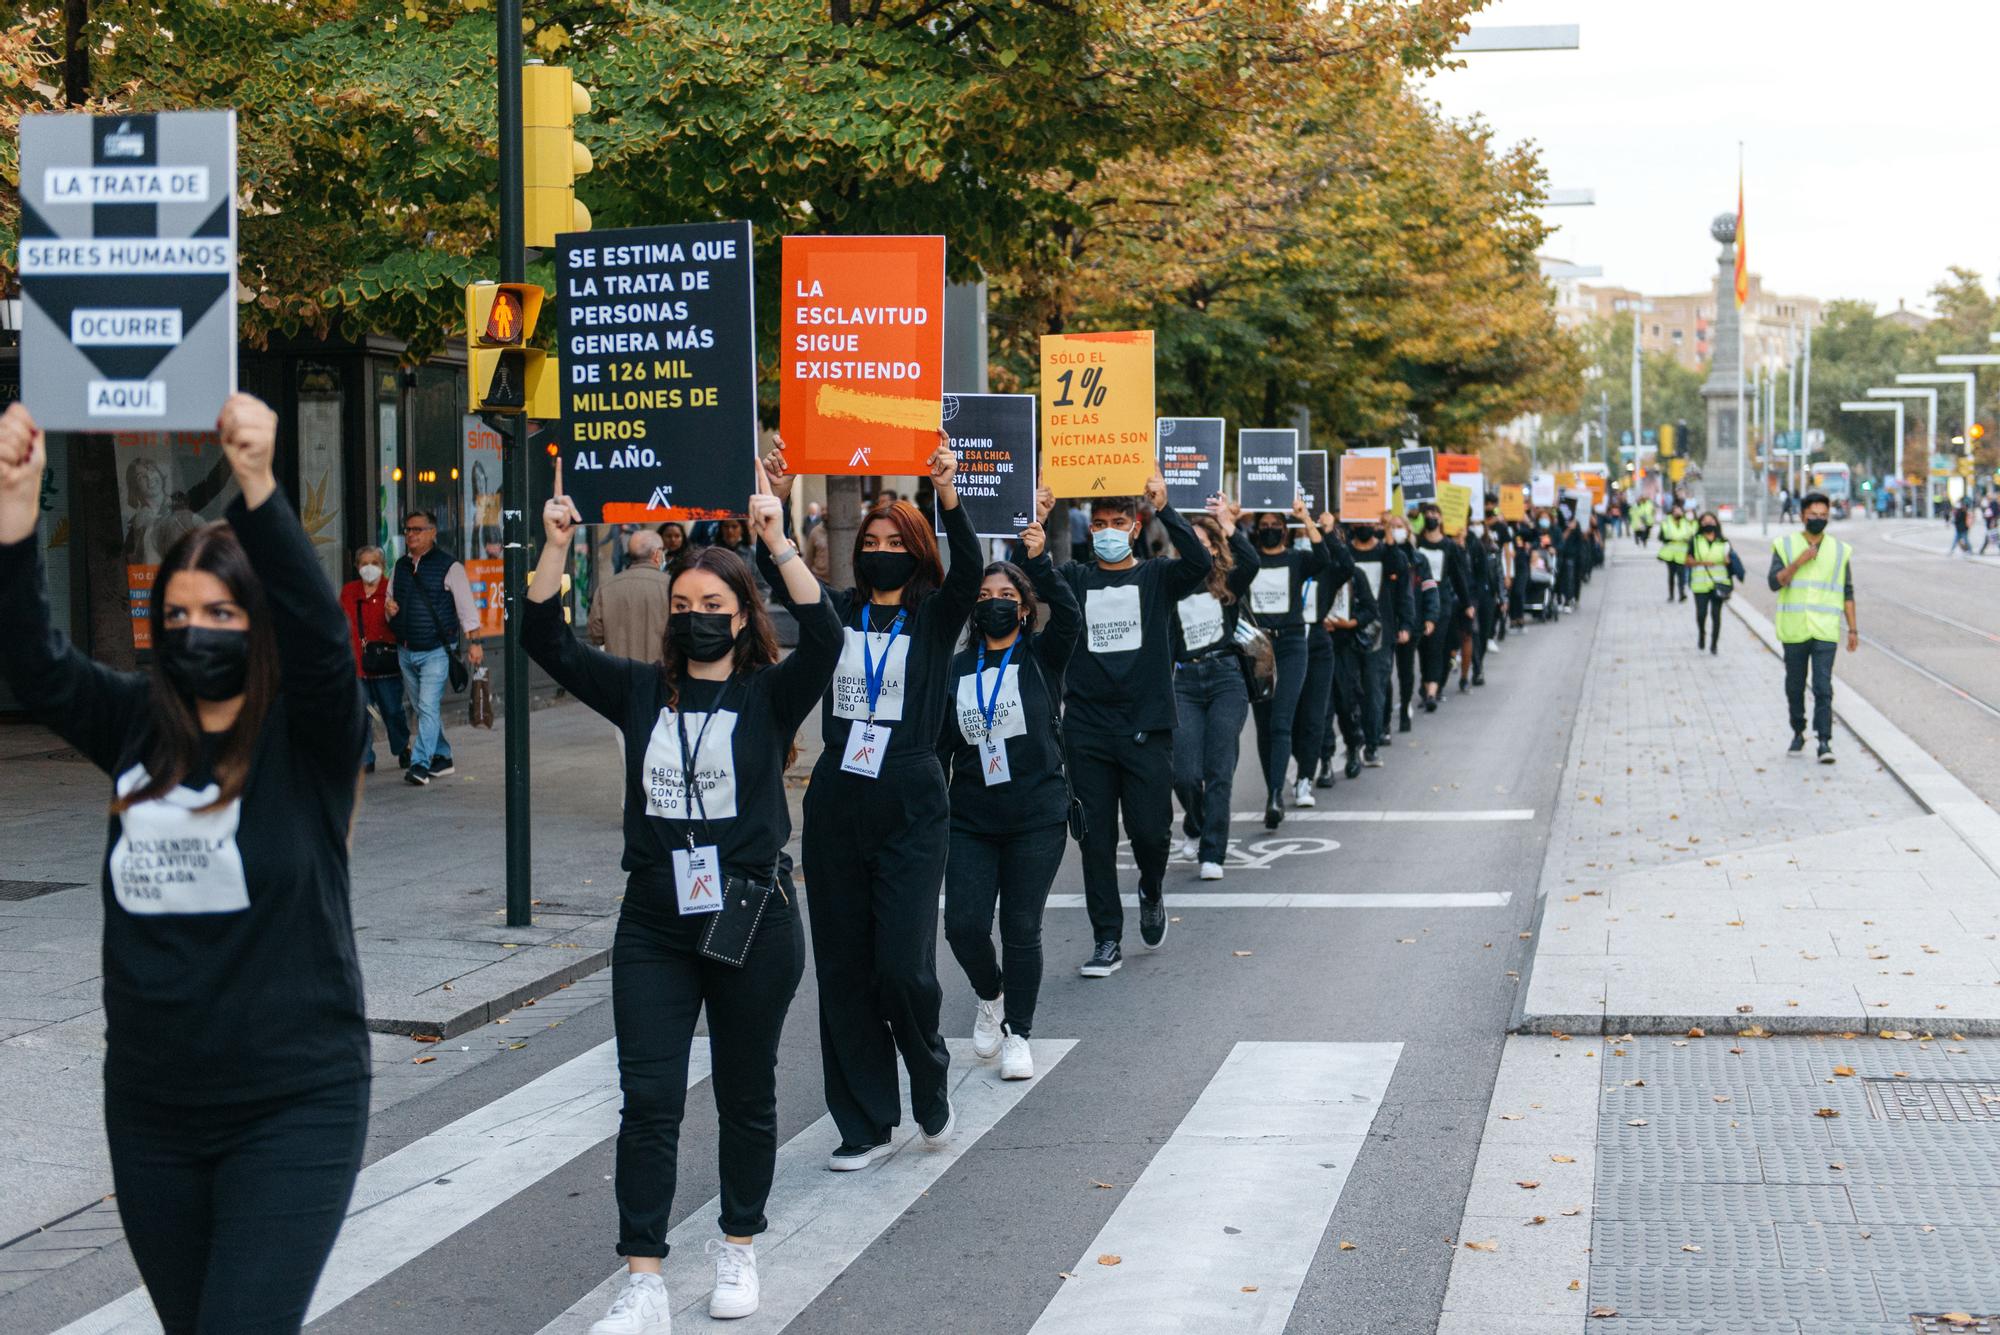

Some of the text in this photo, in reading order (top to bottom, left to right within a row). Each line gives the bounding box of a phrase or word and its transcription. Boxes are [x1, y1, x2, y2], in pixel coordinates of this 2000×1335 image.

[53, 173, 199, 195] LA TRATA DE
[28, 245, 226, 266] SERES HUMANOS
[569, 240, 736, 268] SE ESTIMA QUE
[570, 271, 710, 297] LA TRATA DE
[797, 280, 823, 297] LA
[571, 301, 688, 326] PERSONAS
[796, 307, 928, 325] ESCLAVITUD
[80, 317, 172, 337] OCURRE
[571, 325, 715, 355] GENERA MÁS
[796, 334, 859, 351] SIGUE
[1050, 351, 1106, 364] SÓLO EL
[572, 360, 693, 384] DE 126 MIL
[795, 361, 921, 379] EXISTIENDO
[1053, 367, 1107, 408] 1%
[573, 387, 719, 412] MILLONES DE
[1051, 413, 1099, 425] DE LAS
[574, 420, 647, 441] EUROS
[958, 438, 993, 448] CAMINO
[1051, 432, 1148, 446] VÍCTIMAS SON
[574, 445, 662, 470] AL AÑO.
[965, 450, 982, 460] ESA
[984, 451, 1011, 460] CHICA
[1052, 453, 1144, 467] RESCATADAS.
[1243, 457, 1252, 465] LA
[959, 461, 1014, 473] 22 AÑOS QUE
[952, 473, 1001, 485] STÁ SIENDO
[1092, 621, 1127, 629] ABOLIENDO
[1093, 627, 1130, 635] ESCLAVITUD
[838, 694, 850, 702] CON
[838, 702, 855, 711] PASO
[965, 720, 1002, 732] CON CDA
[969, 730, 986, 738] PASO
[714, 769, 726, 779] LA
[651, 788, 672, 797] CON
[652, 799, 677, 808] PASO
[121, 871, 196, 884] CON CADA
[124, 887, 162, 899] PASO
